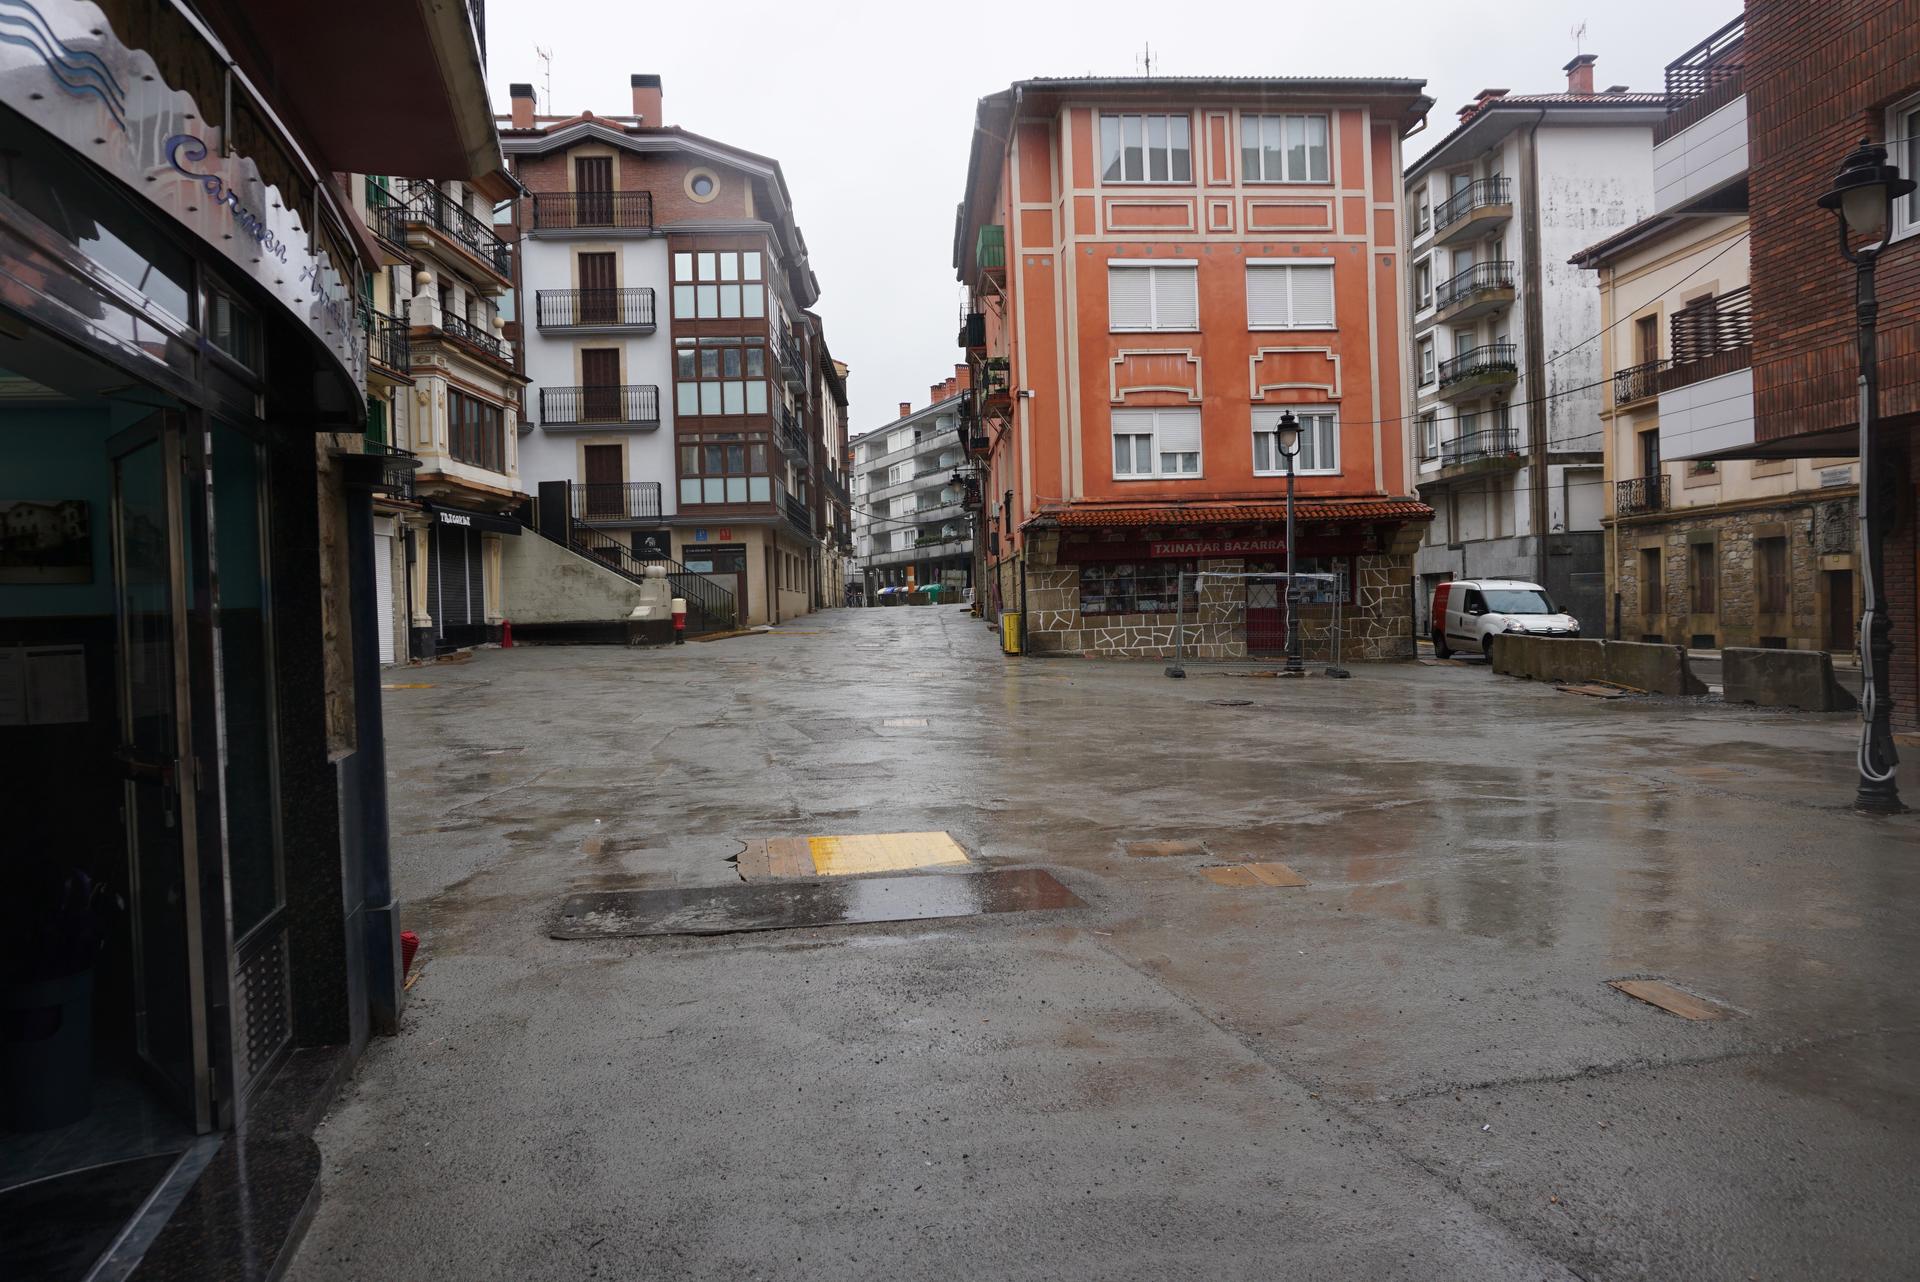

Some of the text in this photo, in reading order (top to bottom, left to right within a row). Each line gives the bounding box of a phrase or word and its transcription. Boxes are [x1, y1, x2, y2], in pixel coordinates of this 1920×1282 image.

[165, 134, 287, 264] Carmen
[1154, 540, 1286, 554] TXINATAR BAZARRA
